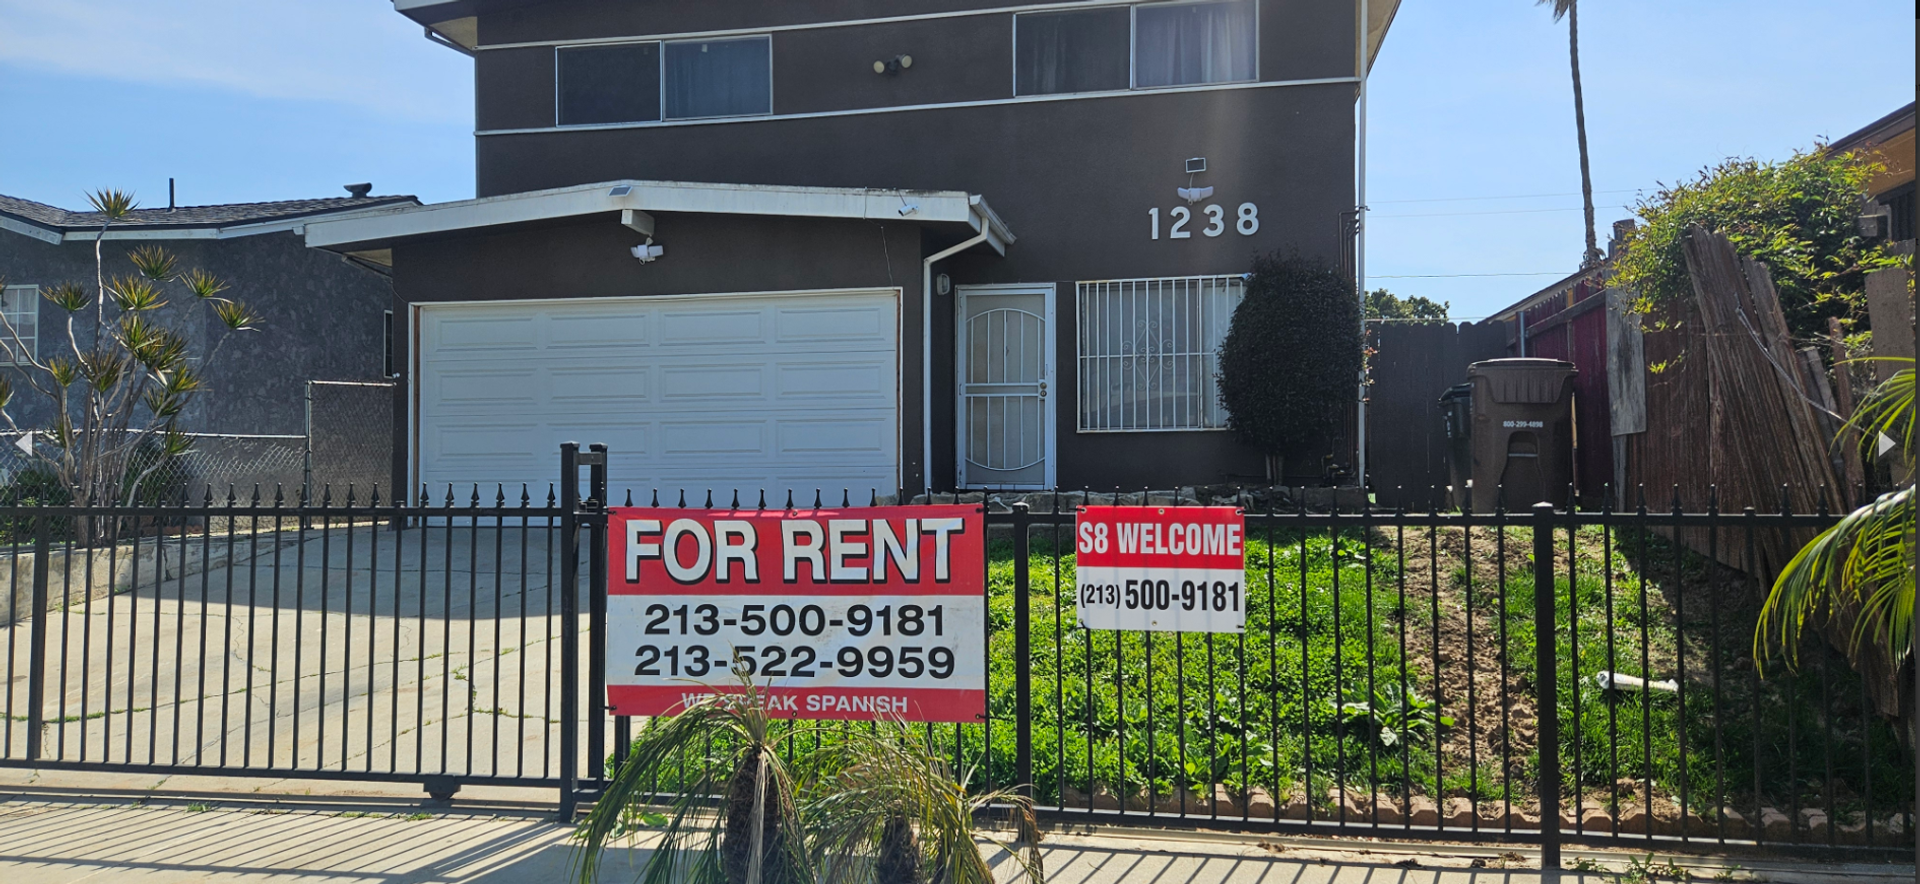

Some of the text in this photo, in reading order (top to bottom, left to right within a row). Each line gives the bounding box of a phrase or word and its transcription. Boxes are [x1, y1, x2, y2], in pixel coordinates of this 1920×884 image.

[1148, 202, 1259, 239] 1238
[625, 517, 964, 584] FOR RENT
[1079, 522, 1241, 556] S8 WELCOME
[1080, 579, 1239, 611] (213) 500-9181
[644, 603, 943, 637] 213-500-9181
[634, 644, 955, 678] 213-522-9959
[806, 694, 908, 713] SPANISH
